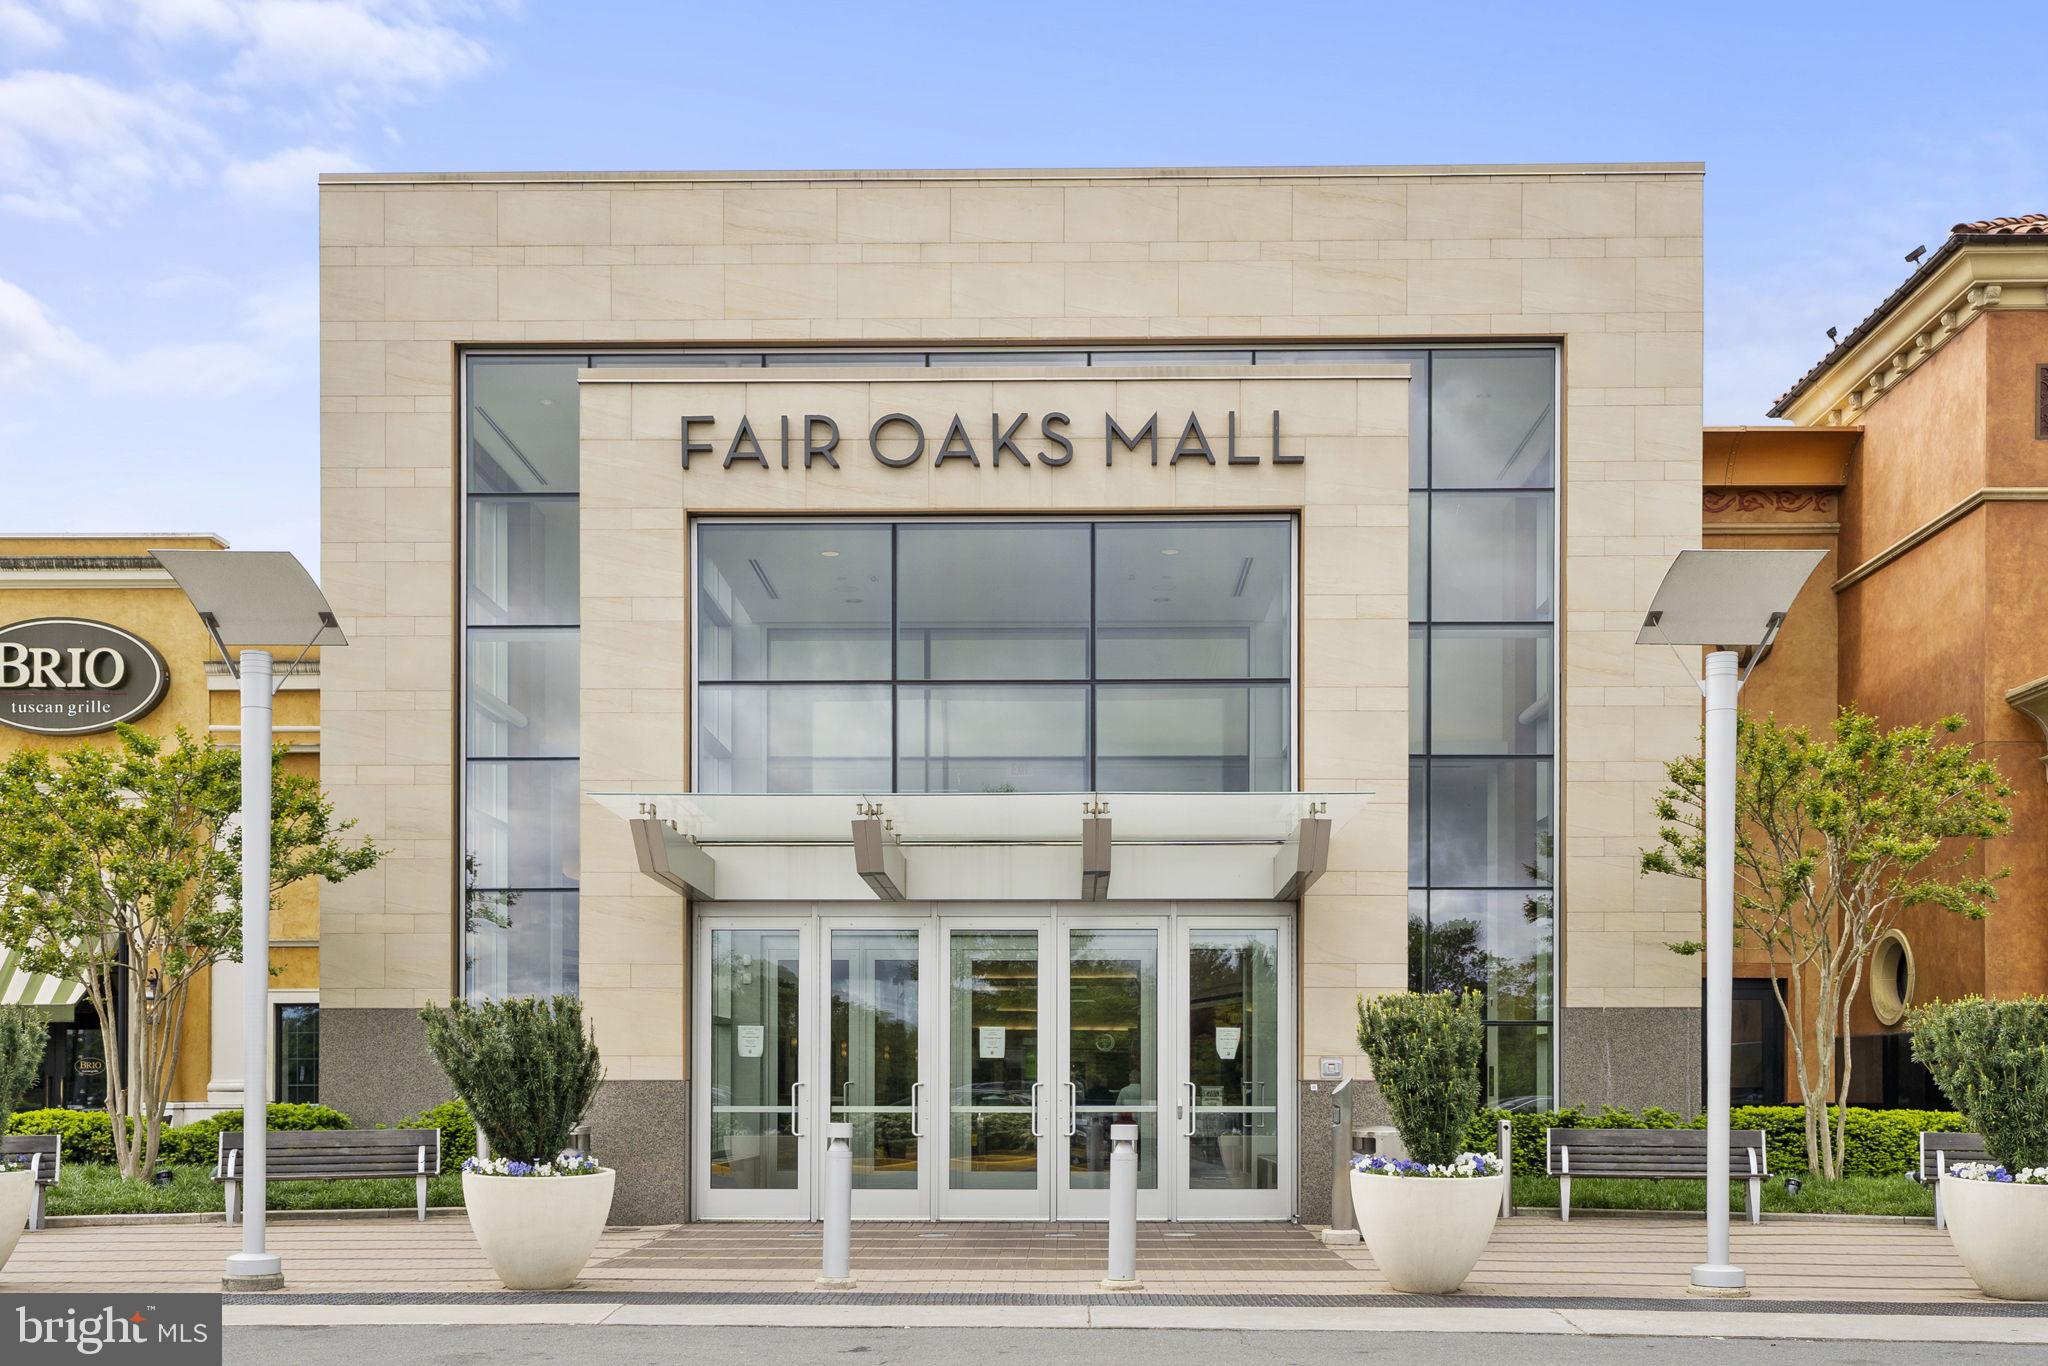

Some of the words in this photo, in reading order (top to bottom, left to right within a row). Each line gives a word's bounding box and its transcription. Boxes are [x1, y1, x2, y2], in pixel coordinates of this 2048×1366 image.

[681, 414, 840, 470] FAIR
[869, 411, 1073, 468] OAKS
[1105, 410, 1305, 466] MALL
[0, 642, 125, 688] BRIO
[11, 702, 63, 713] tuscan
[67, 700, 111, 716] grille
[80, 1061, 102, 1070] BRIO
